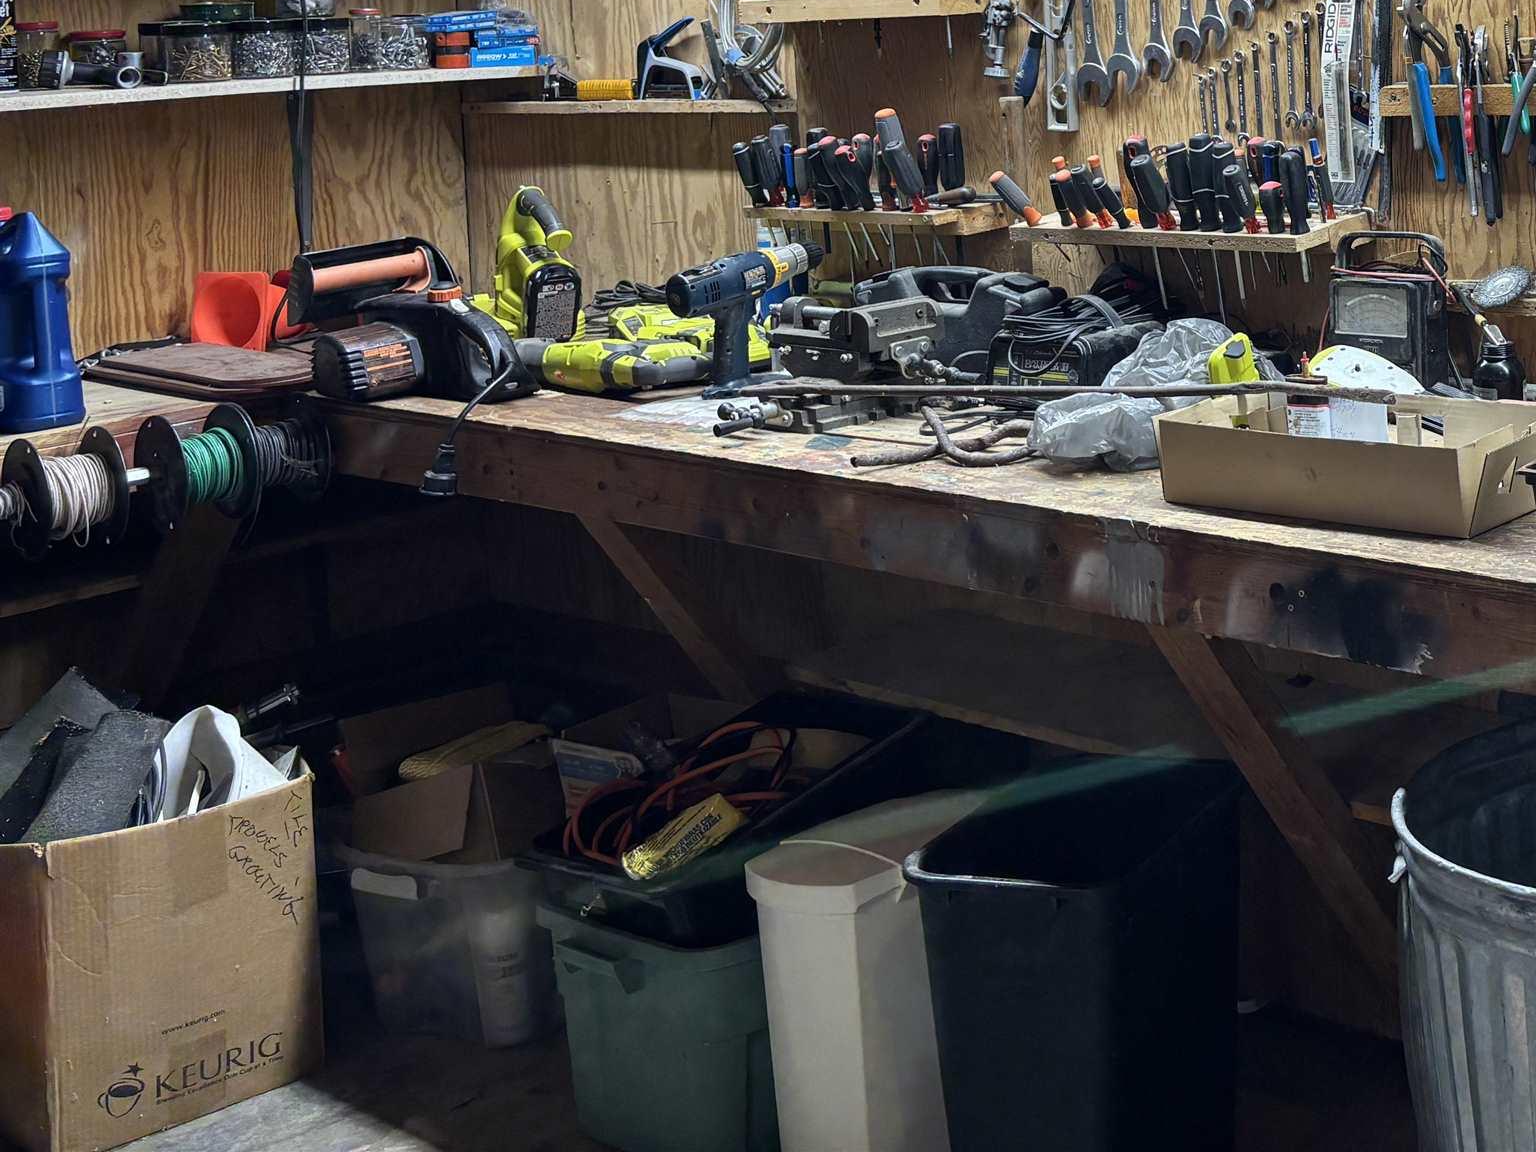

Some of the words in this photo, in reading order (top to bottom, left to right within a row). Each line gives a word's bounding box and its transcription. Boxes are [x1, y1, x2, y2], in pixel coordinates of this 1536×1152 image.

[1324, 4, 1336, 54] RIDGID
[284, 791, 308, 847] TILE
[156, 1032, 283, 1099] KEURIG
